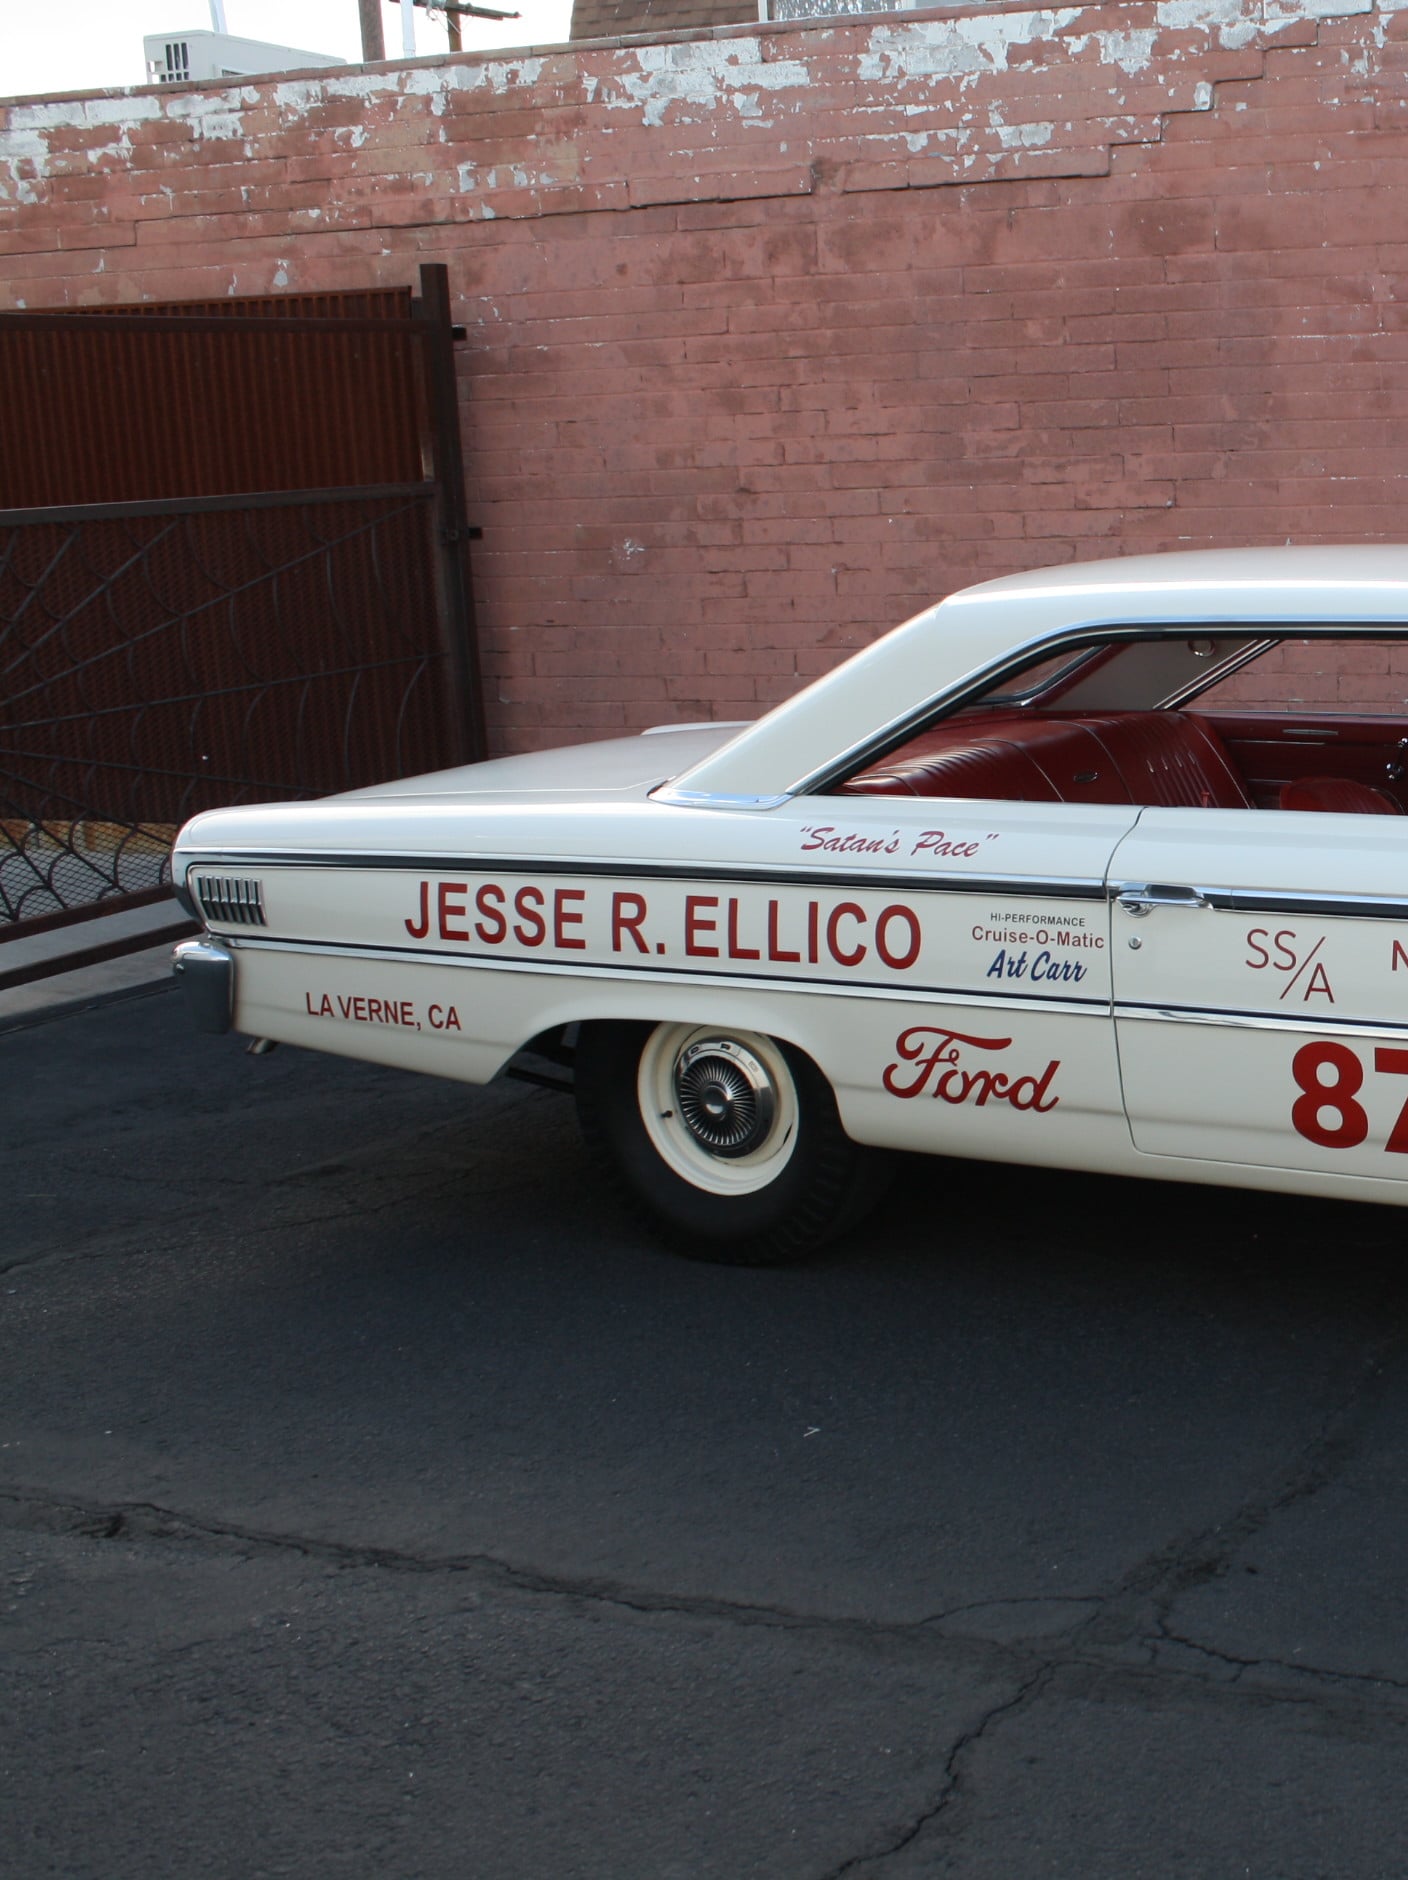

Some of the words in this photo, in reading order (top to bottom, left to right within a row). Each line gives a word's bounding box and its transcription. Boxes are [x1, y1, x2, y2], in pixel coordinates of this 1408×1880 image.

[405, 880, 588, 951] JESSE
[611, 891, 668, 956] R.
[685, 894, 923, 971] ELLICO
[971, 925, 1106, 950] Cruise-O-Matic
[990, 912, 1087, 928] HI-PERFORMANCE
[987, 948, 1028, 980] Art
[1030, 950, 1088, 983] Carr
[305, 991, 334, 1016] LA
[336, 994, 422, 1031] VERNE,
[428, 1003, 462, 1031] CA
[882, 1026, 1061, 1113] Ford
